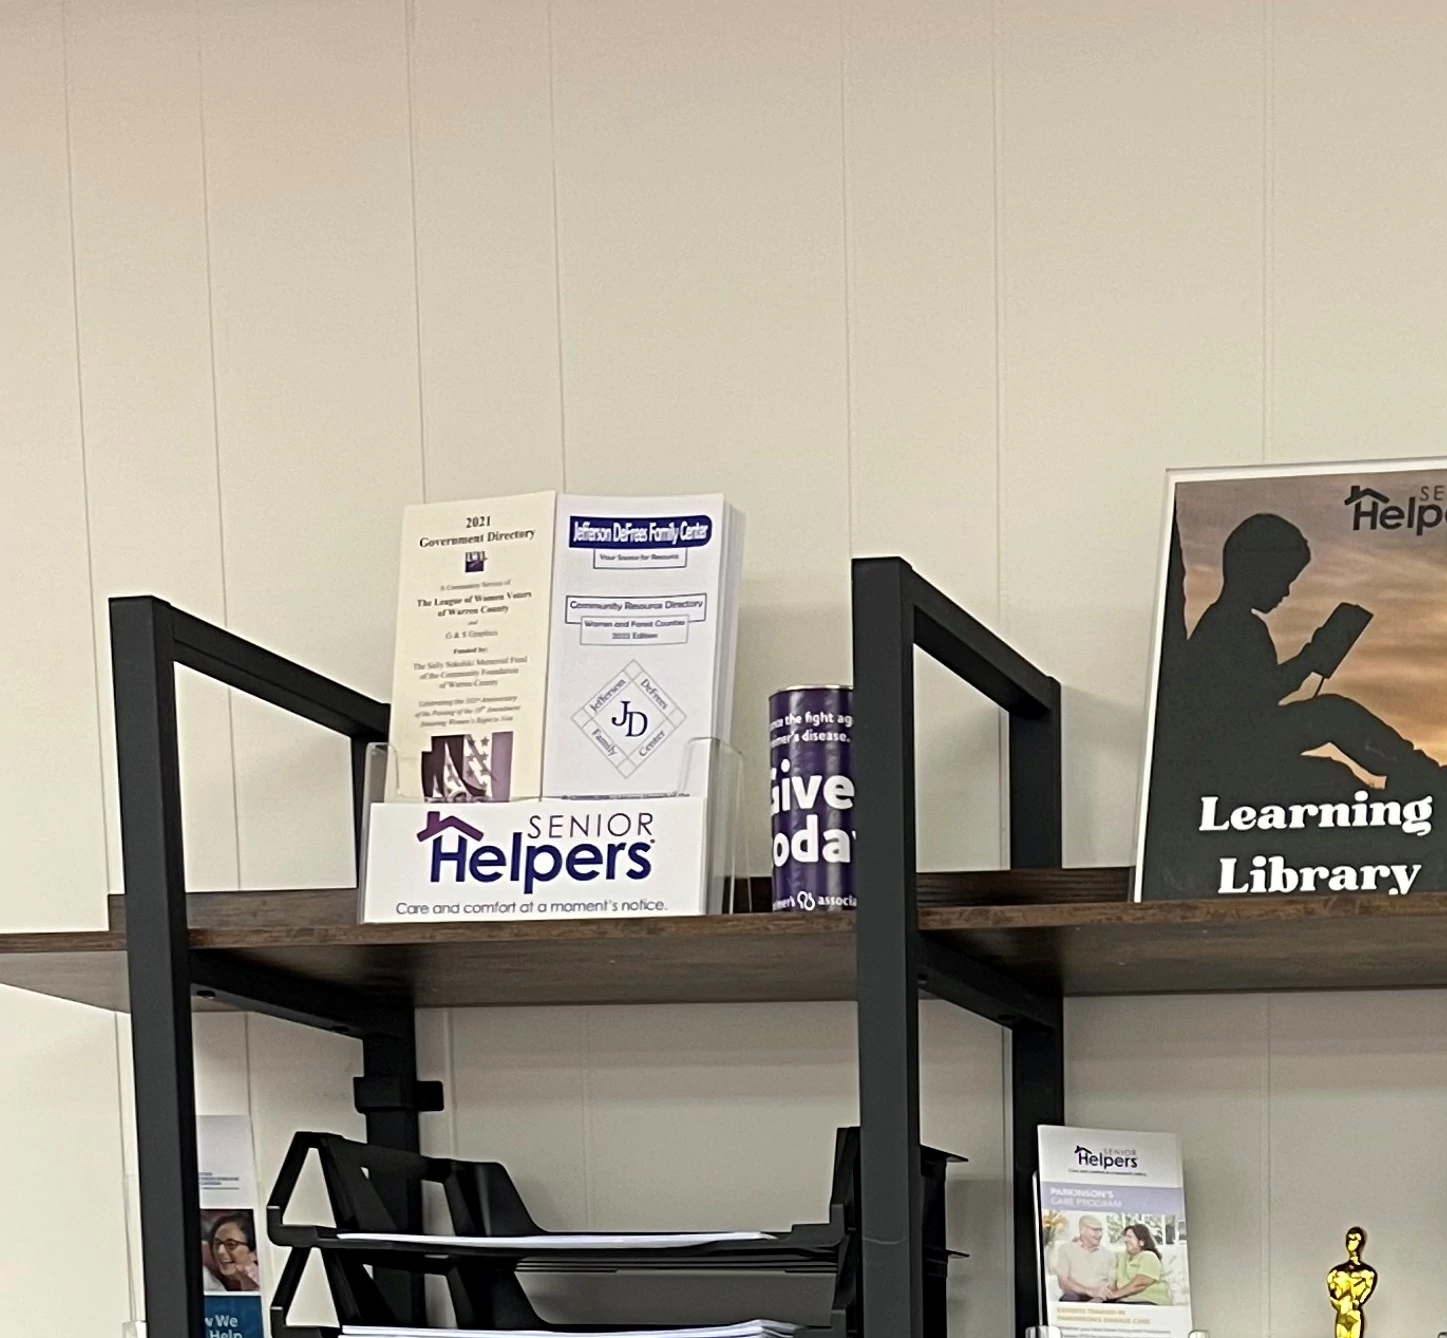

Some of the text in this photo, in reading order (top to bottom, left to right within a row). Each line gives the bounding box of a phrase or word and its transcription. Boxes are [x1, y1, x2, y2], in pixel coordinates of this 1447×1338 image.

[466, 516, 491, 528] 2021
[419, 529, 536, 548] Government Directory
[574, 521, 708, 544] Jefferson DeFrees Family Center
[570, 601, 622, 611] Community
[665, 600, 703, 609] Directory
[611, 700, 648, 737] JD
[805, 711, 834, 727] fight
[802, 730, 850, 742] disease.
[1199, 790, 1433, 836] Learning
[527, 812, 654, 838] SENIOR
[430, 832, 652, 895] Helpers
[1217, 855, 1422, 896] Library
[397, 903, 429, 914] Care
[433, 902, 459, 914] and
[464, 902, 515, 913] comfort
[520, 902, 534, 912] at
[551, 900, 618, 912] moment's
[622, 899, 668, 911] notice.
[1103, 1147, 1136, 1156] SENIOR
[1079, 1153, 1137, 1170] Helpers
[1051, 1188, 1114, 1198] PARKINSON'S
[1077, 1198, 1122, 1207] PROGRAM
[216, 1315, 238, 1328] We
